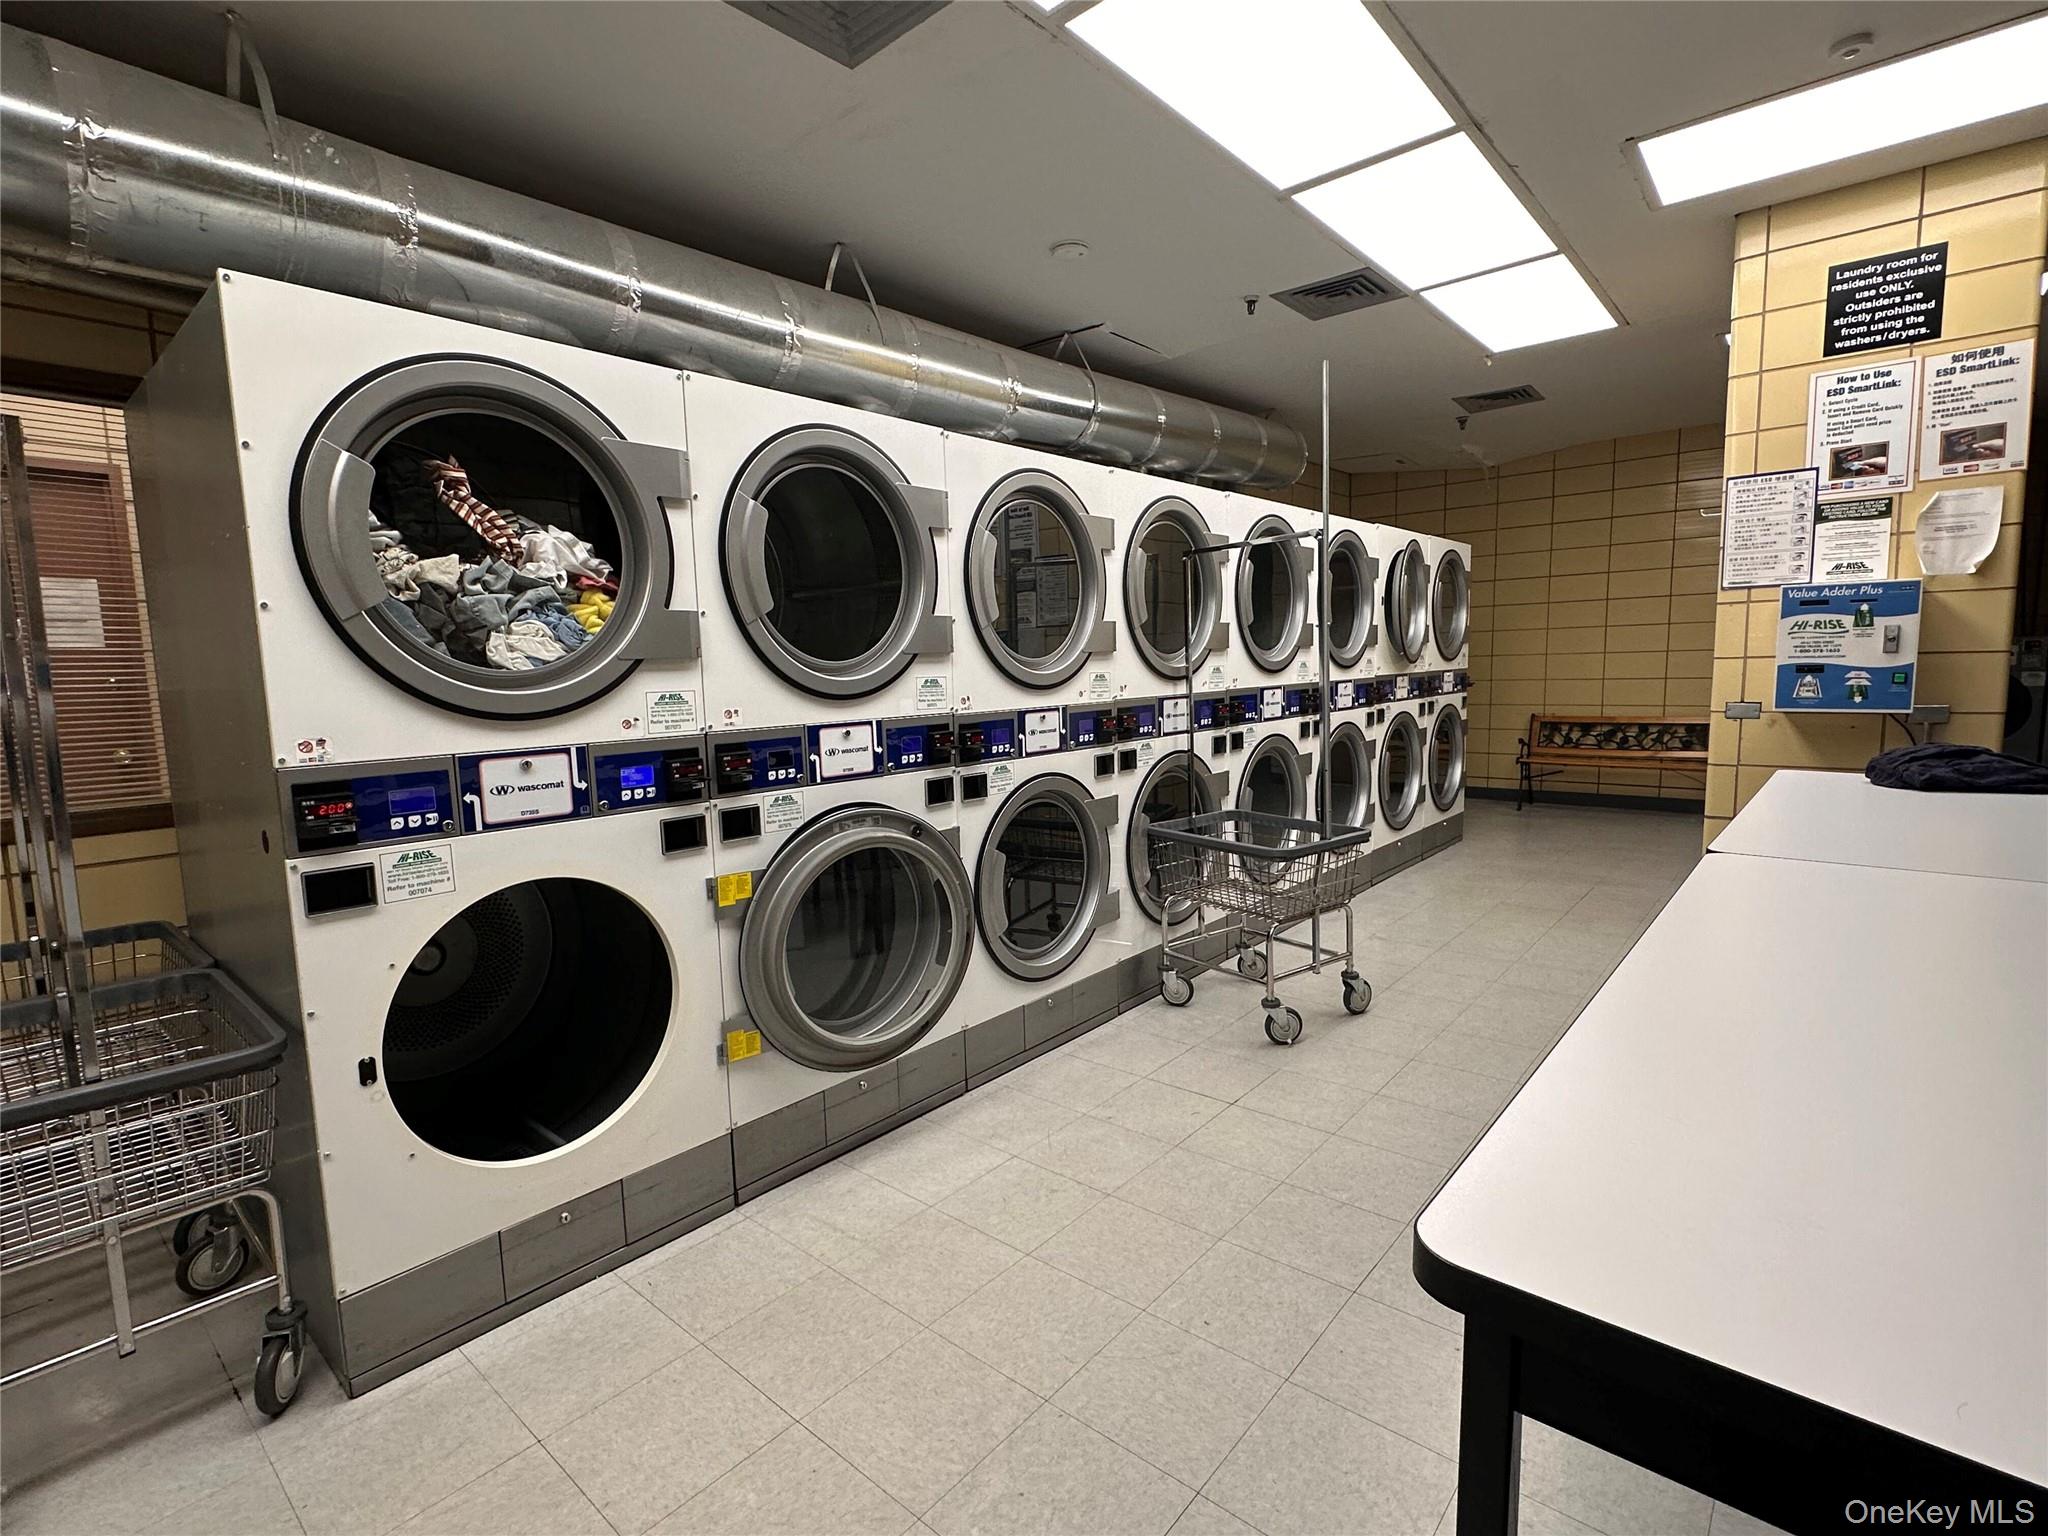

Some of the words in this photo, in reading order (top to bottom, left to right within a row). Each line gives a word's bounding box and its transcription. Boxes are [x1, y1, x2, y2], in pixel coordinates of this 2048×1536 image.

[1836, 263, 1884, 280] Laundry
[1887, 257, 1917, 270] room
[1921, 252, 1938, 262] for
[1831, 276, 1883, 292] residents
[1886, 264, 1942, 280] exclusive
[1856, 289, 1876, 299] use
[1879, 280, 1914, 294] ONLY.
[1845, 295, 1901, 312] Outsiders
[1904, 292, 1923, 302] are
[1833, 312, 1872, 326] strictly
[1875, 300, 1936, 320] prohibited
[1841, 326, 1867, 336] from
[1871, 320, 1902, 331] using
[1906, 315, 1925, 324] the
[1834, 326, 1930, 348] washers/dryers.
[1951, 346, 2005, 364] 如何使用
[1936, 367, 1957, 378] ESD
[1960, 357, 2020, 373] SmartLink:
[1837, 376, 1858, 385] How
[1874, 370, 1892, 378] Use
[1827, 388, 1845, 397] ESD
[1848, 380, 1902, 394] SmartLink:
[1832, 561, 1868, 570] HI-RISE
[1788, 589, 1818, 598] Value
[1821, 586, 1857, 597] Adder
[1860, 585, 1884, 594] Plus
[1789, 619, 1846, 630] HI-RISE
[841, 746, 868, 754] wascomat
[518, 780, 564, 792] wascomat
[397, 850, 437, 863] HI-RISE
[408, 887, 432, 895] 007074
[417, 878, 445, 887] machine
